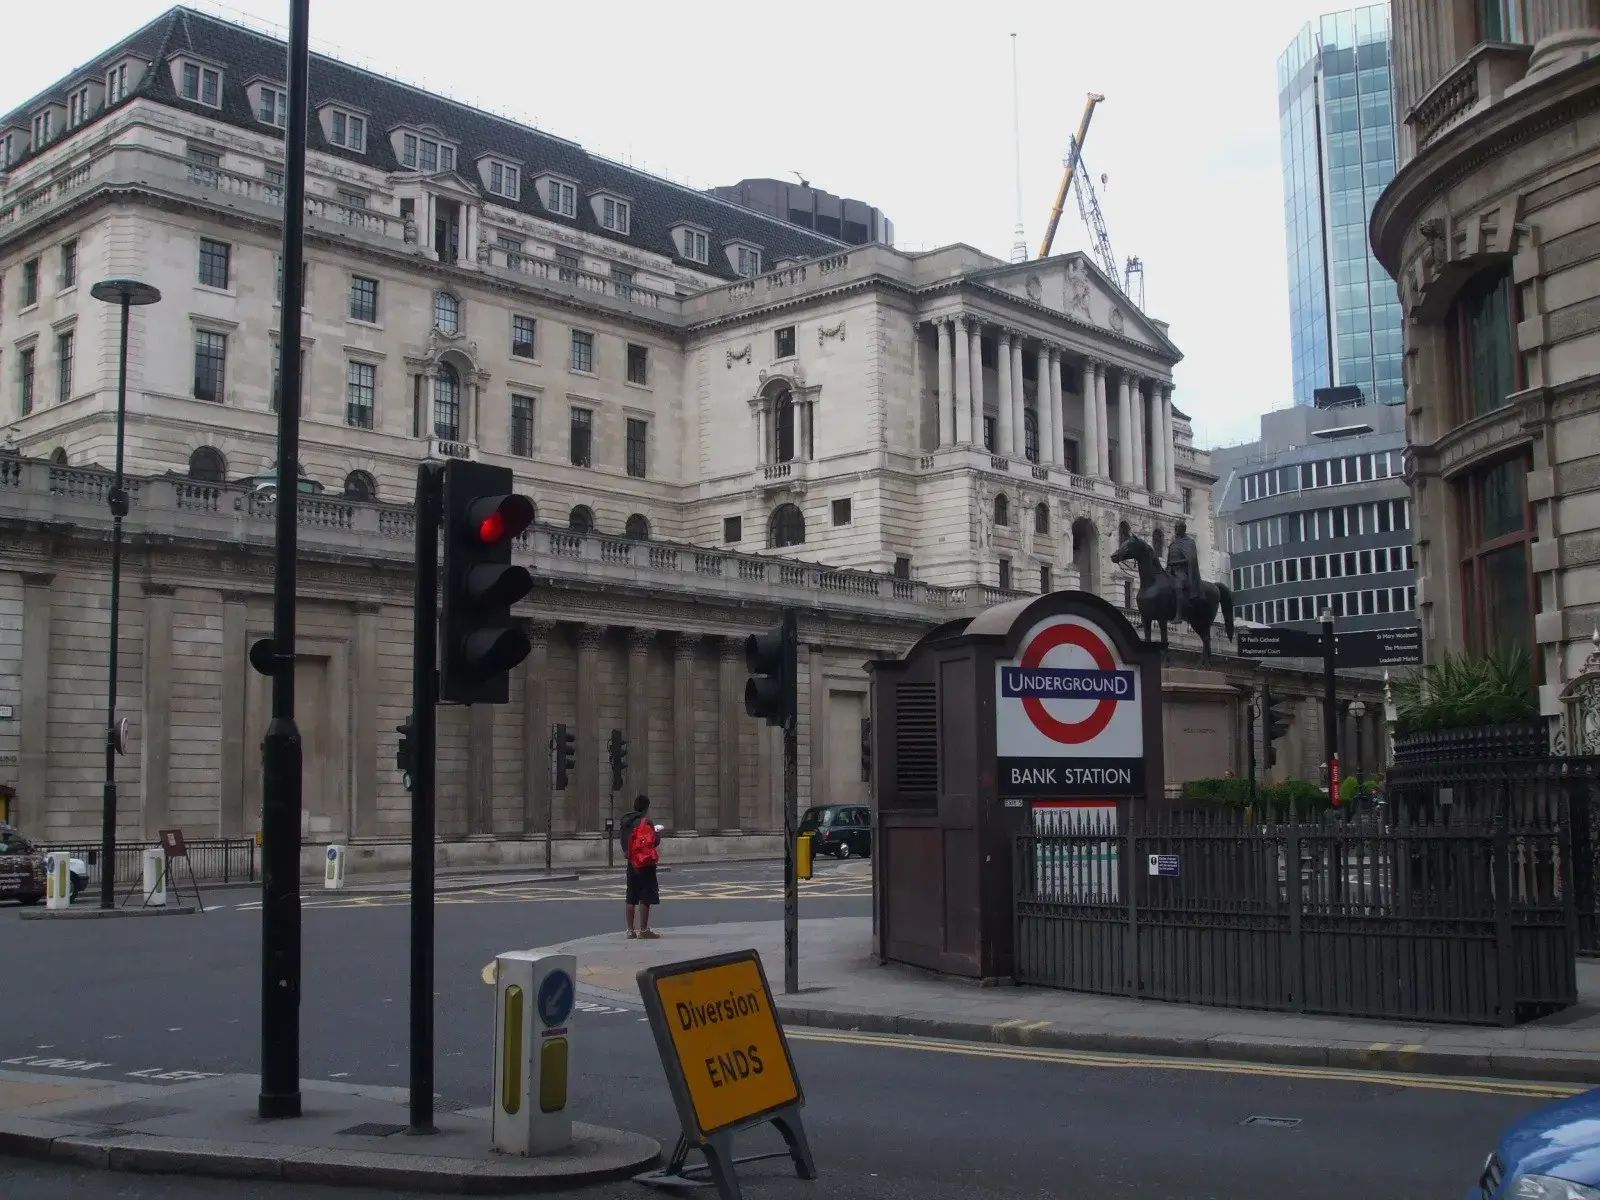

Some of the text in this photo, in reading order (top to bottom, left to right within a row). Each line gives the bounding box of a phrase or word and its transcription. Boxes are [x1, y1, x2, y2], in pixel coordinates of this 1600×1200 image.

[1011, 768, 1131, 784] BANK STATION
[675, 990, 760, 1031] Diversion
[1, 1055, 112, 1071] LOOK
[704, 1045, 764, 1088] ENDS
